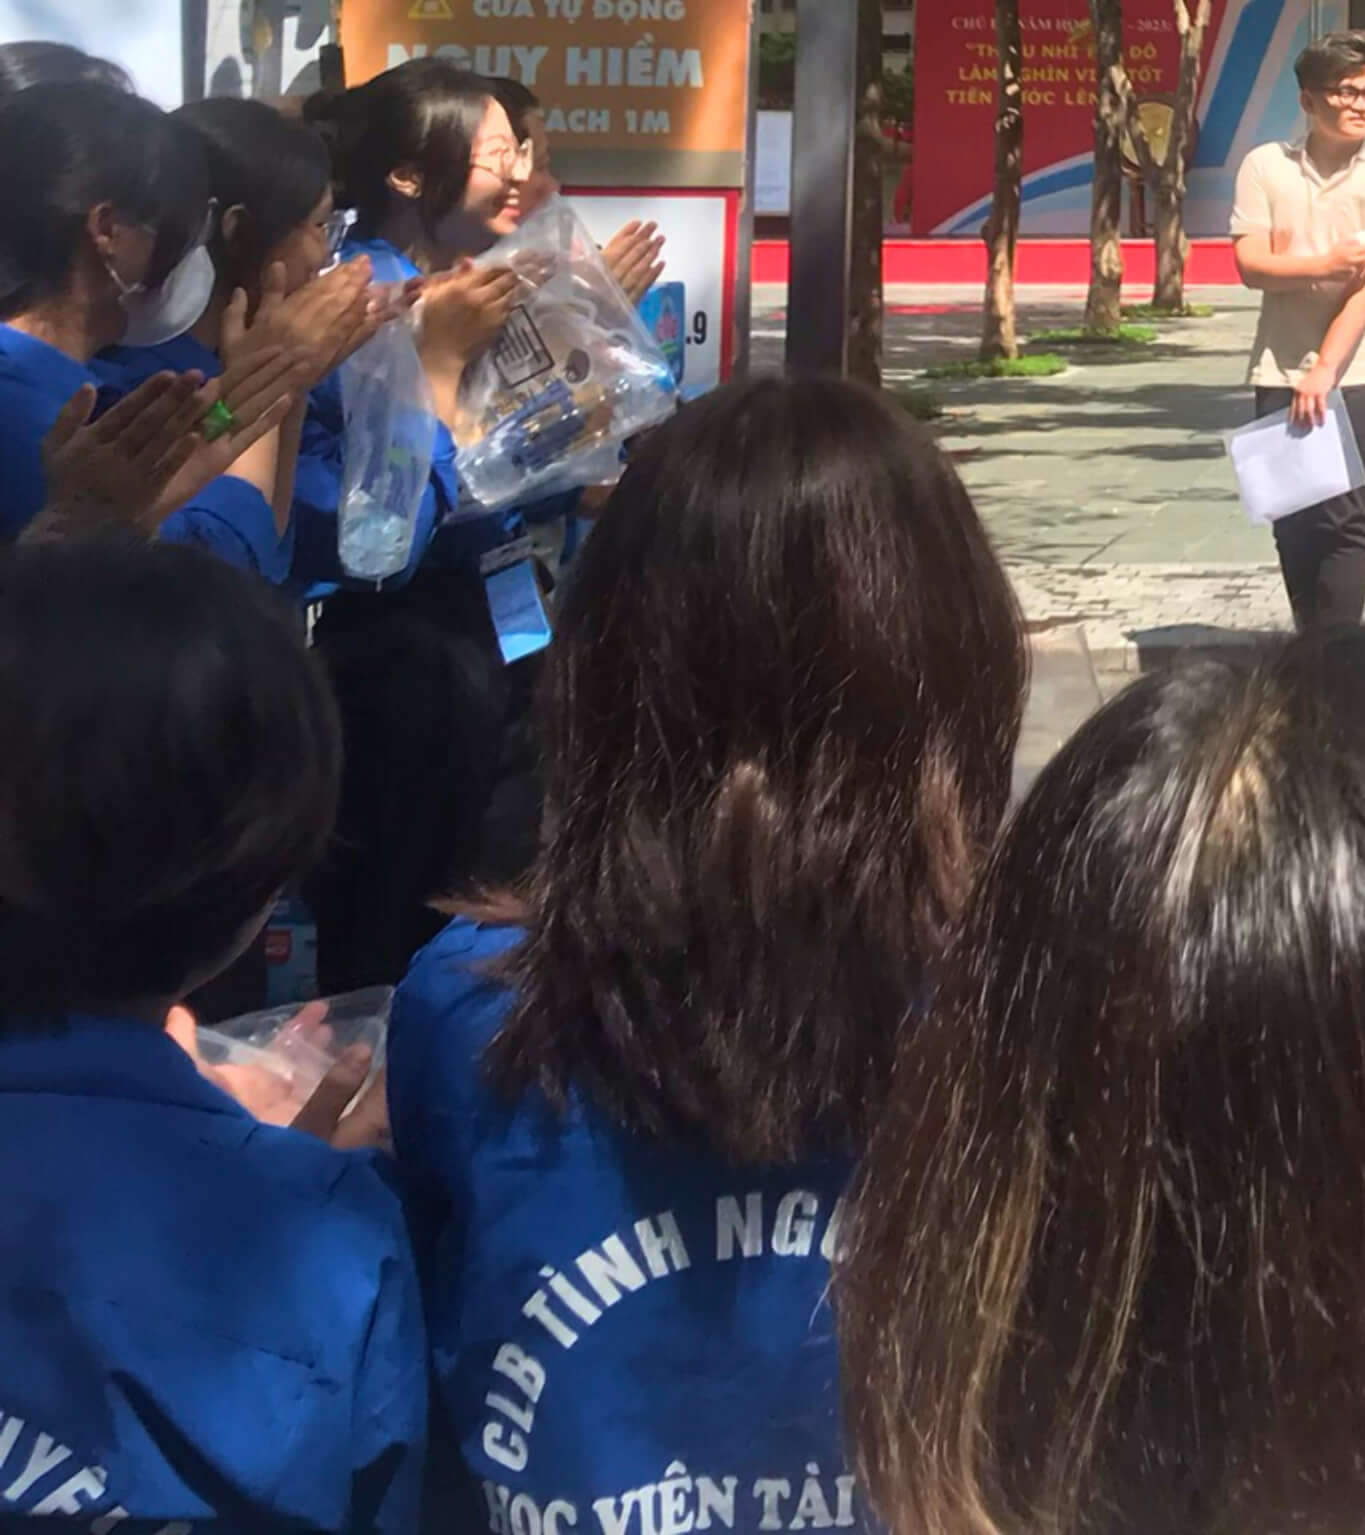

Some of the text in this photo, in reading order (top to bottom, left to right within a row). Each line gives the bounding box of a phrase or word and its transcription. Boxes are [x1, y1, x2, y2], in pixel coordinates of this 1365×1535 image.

[565, 32, 704, 88] HIỂM
[625, 109, 671, 134] 1M
[482, 1342, 547, 1472] CLB
[521, 1210, 692, 1349] TÌNH
[752, 1461, 857, 1529] TÀI
